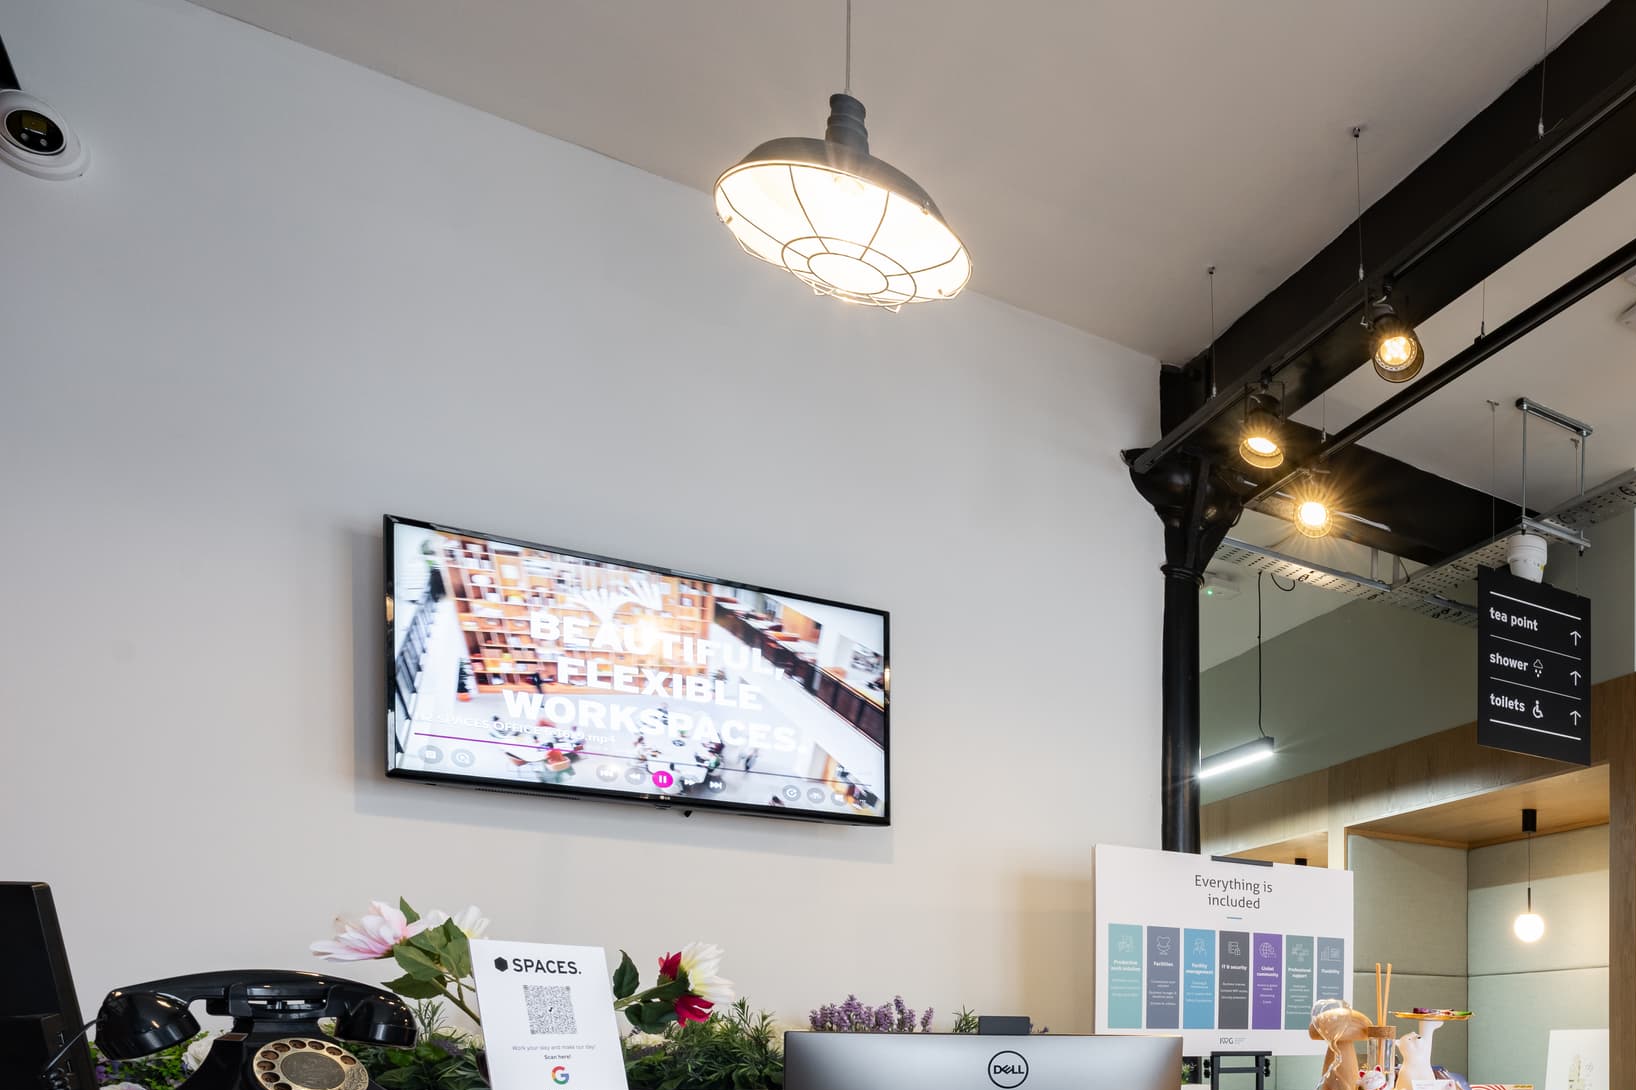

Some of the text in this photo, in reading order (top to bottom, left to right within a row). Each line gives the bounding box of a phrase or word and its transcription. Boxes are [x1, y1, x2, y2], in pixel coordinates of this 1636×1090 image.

[1489, 607, 1539, 632] tea point
[1489, 652, 1529, 671] shower
[557, 655, 763, 711] FLEXIBLE
[1489, 693, 1526, 712] toilets
[1194, 874, 1273, 895] Everything is
[1207, 893, 1261, 910] included
[512, 957, 583, 976] SPACES.
[993, 1063, 1025, 1076] DELL
